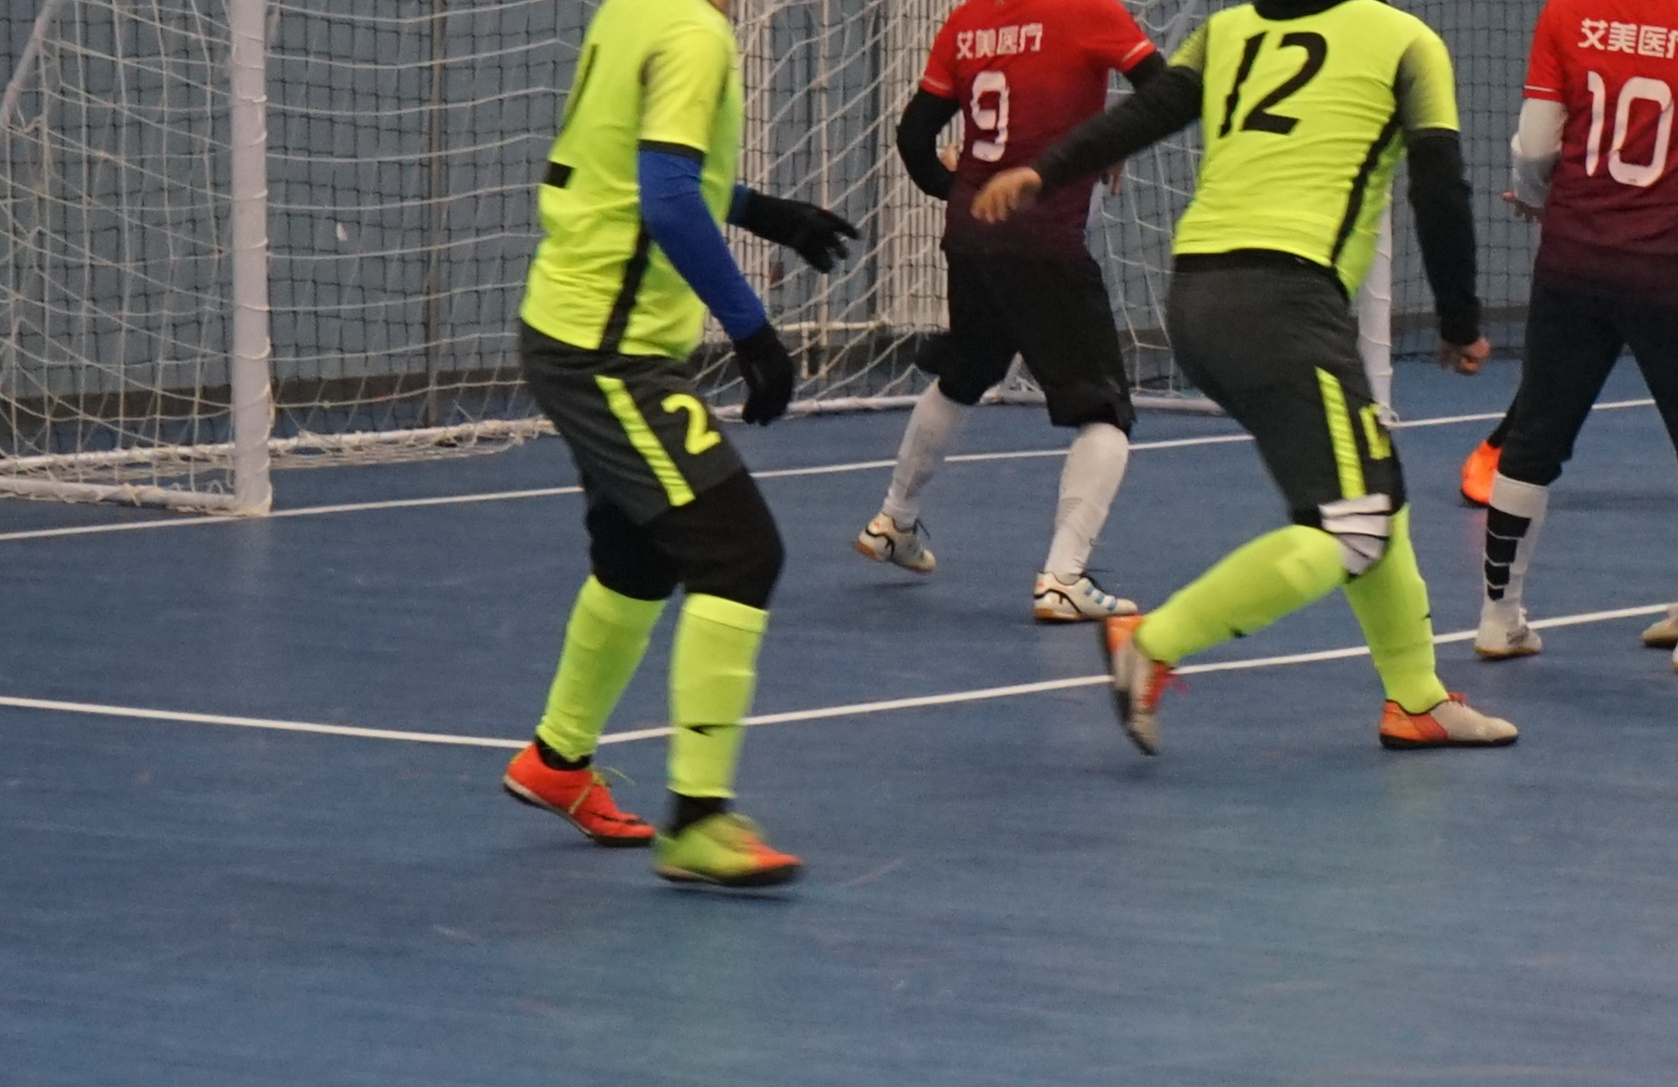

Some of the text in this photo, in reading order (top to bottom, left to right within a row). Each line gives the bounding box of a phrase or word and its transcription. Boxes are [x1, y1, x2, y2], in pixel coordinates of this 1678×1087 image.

[956, 23, 1043, 60] 艾美医疗
[1217, 30, 1328, 139] 12
[970, 70, 1010, 162] 9
[1585, 70, 1675, 188] 10
[660, 393, 721, 454] 2
